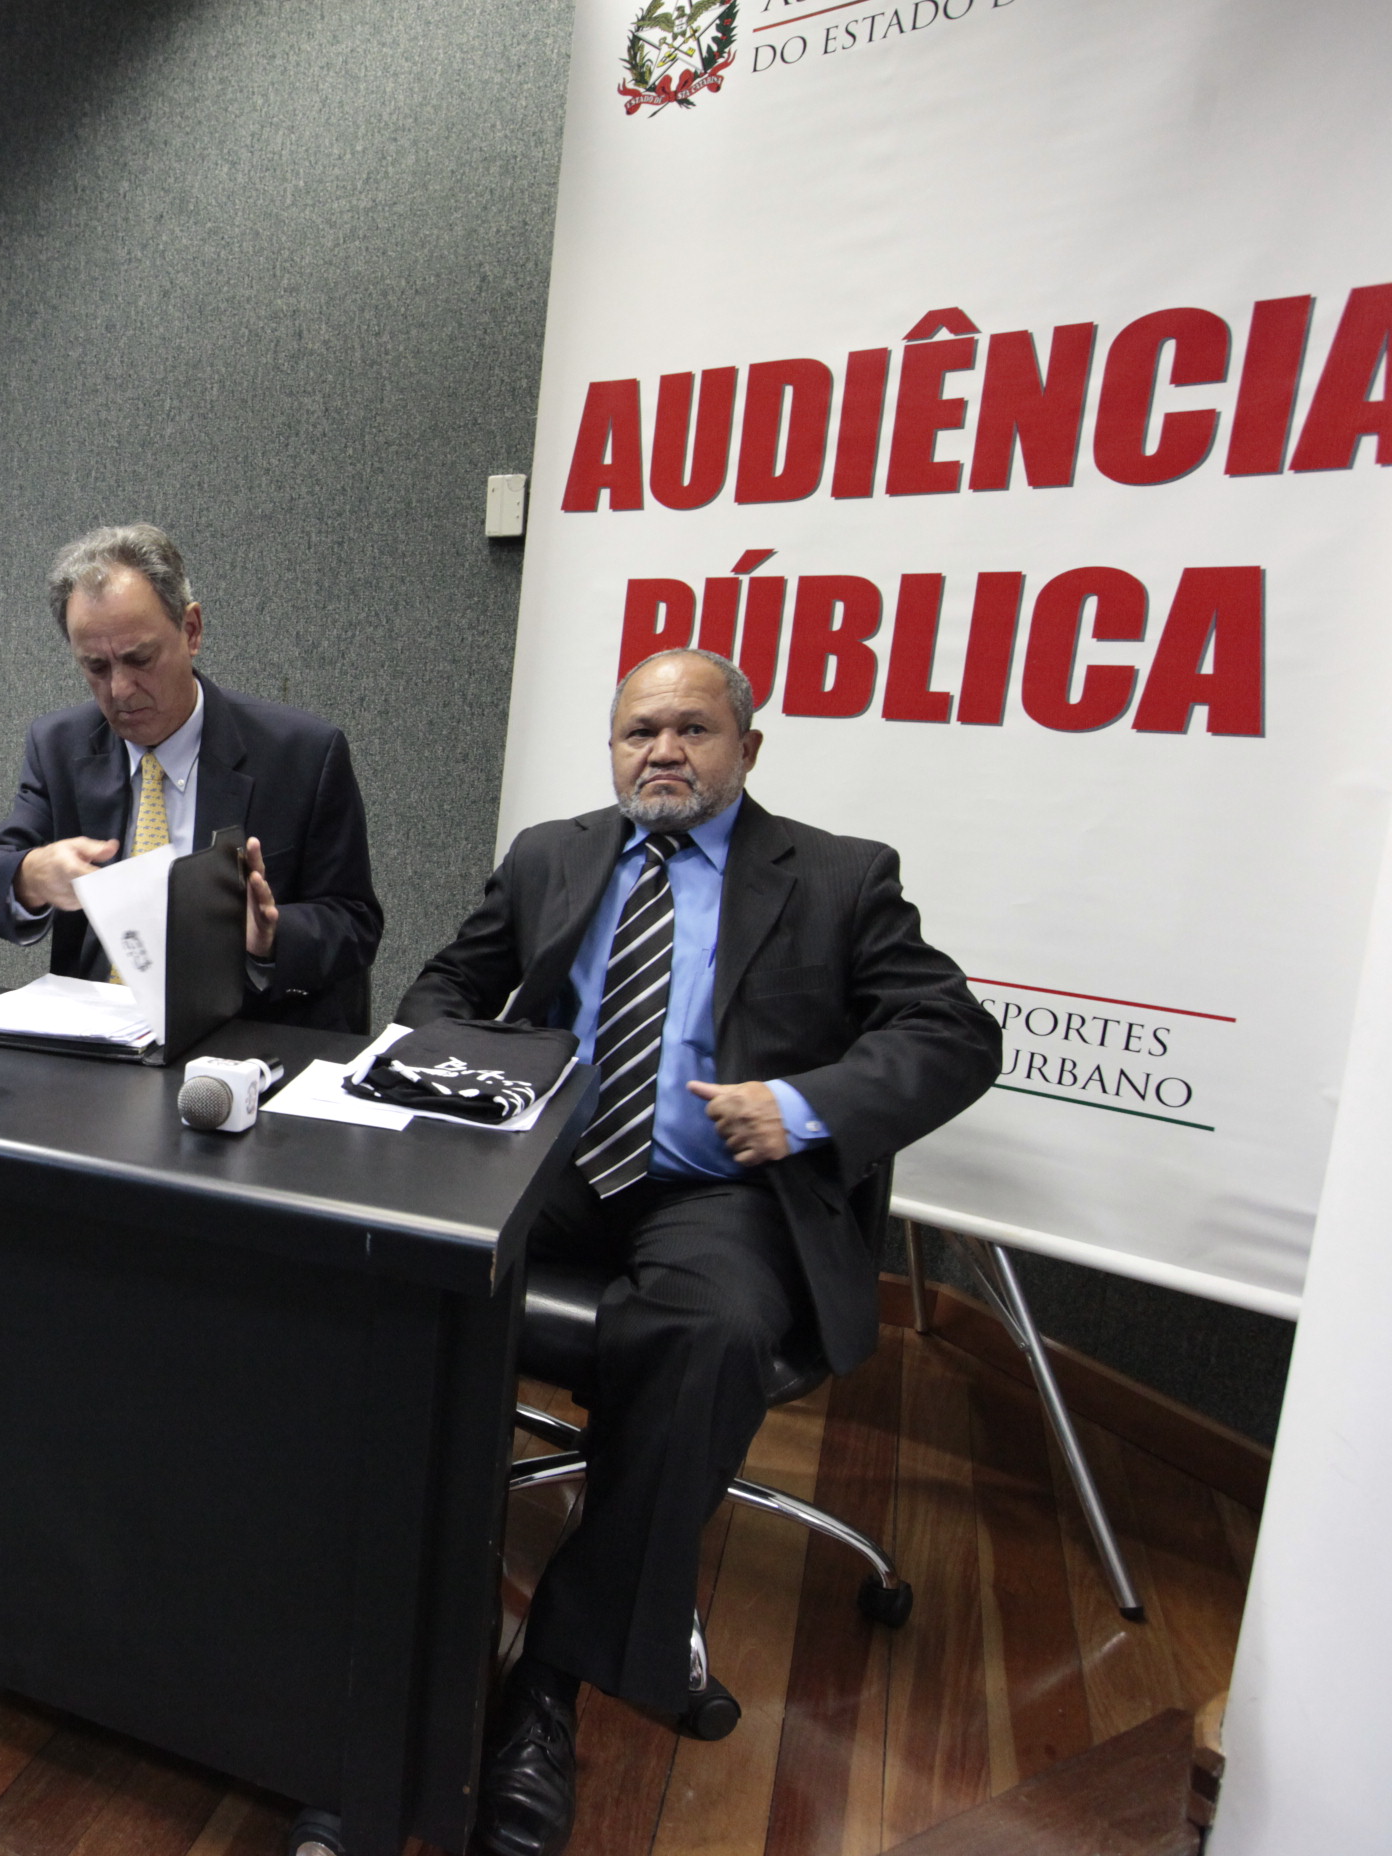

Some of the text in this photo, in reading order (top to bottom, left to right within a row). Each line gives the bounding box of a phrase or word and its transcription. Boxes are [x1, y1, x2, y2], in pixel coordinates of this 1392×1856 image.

[751, 0, 974, 74] DO ESTADO
[561, 282, 1392, 512] AUDIÊNCIA
[616, 549, 1266, 738] PÚBLICA
